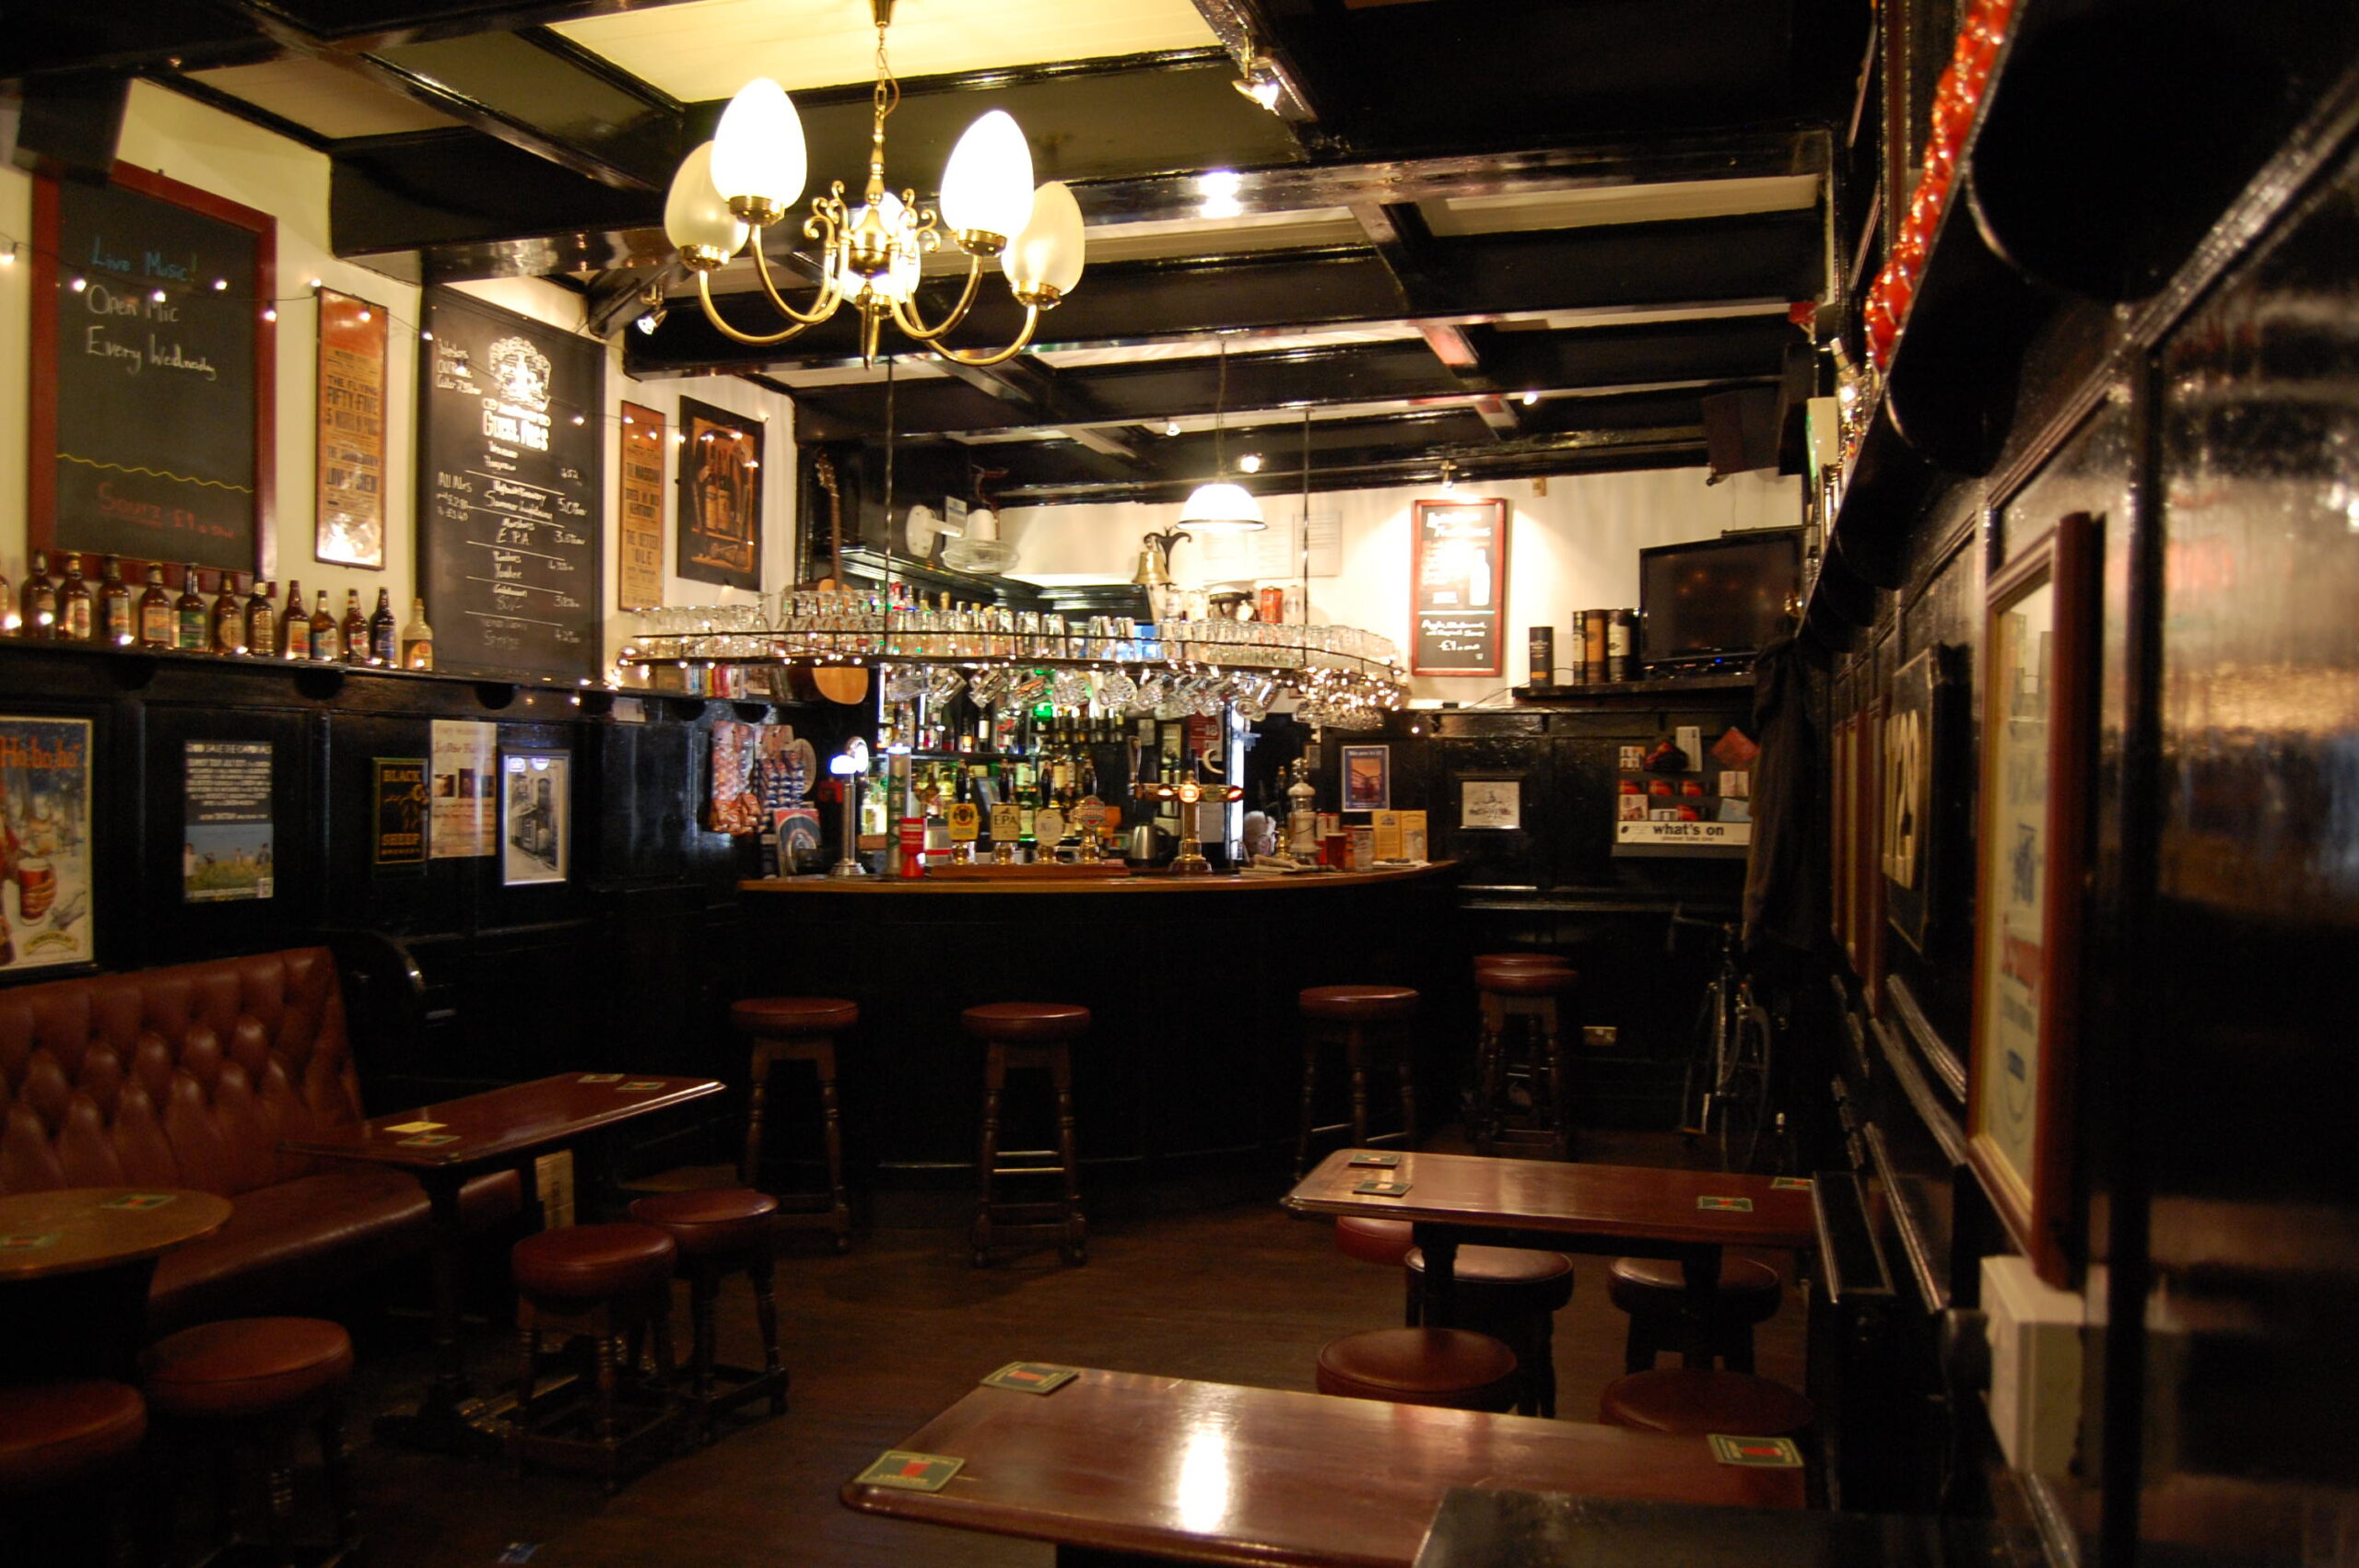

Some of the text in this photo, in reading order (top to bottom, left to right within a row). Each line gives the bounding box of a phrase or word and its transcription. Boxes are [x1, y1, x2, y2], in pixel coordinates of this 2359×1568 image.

[91, 236, 132, 271] Live
[88, 285, 180, 322] Open Mic
[87, 325, 142, 376] Every
[993, 815, 1018, 826] EPA
[1653, 824, 1725, 836] what's on
